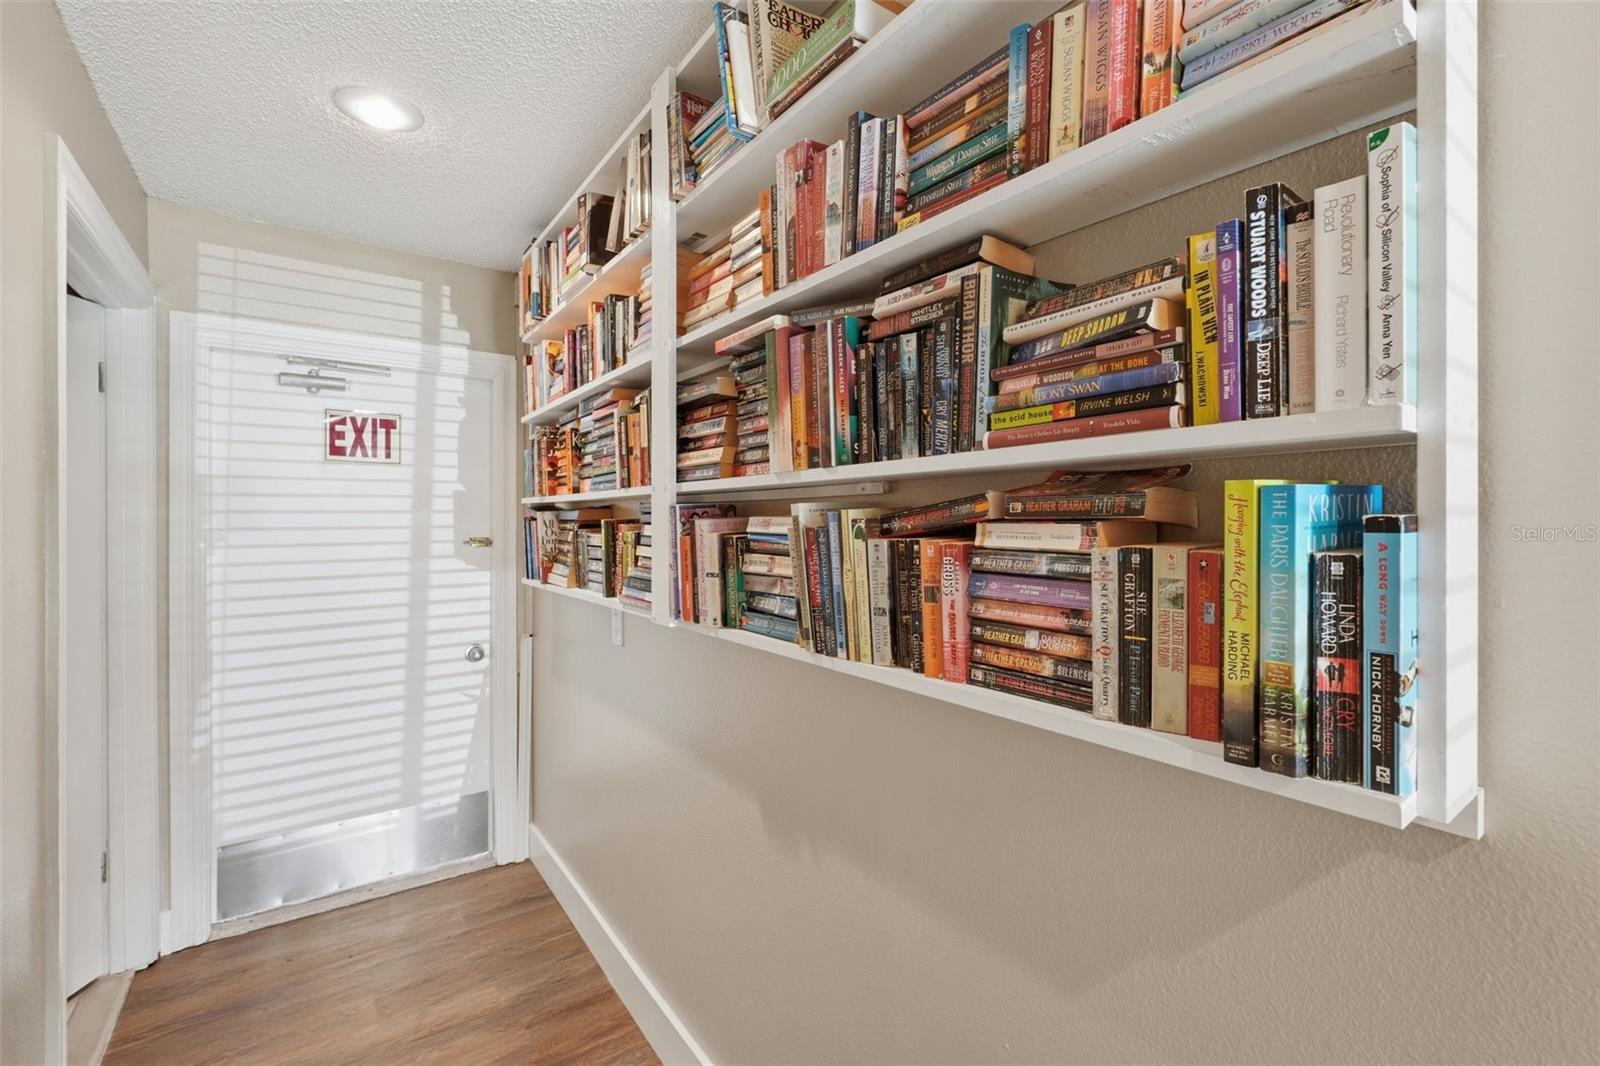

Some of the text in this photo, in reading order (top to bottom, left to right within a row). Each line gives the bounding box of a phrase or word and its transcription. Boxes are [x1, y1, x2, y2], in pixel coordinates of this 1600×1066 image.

[1114, 4, 1128, 80] SUSAN WIGGS
[1153, 12, 1165, 48] WIGGS
[1217, 34, 1270, 65] SHERRYL
[1273, 7, 1323, 38] WOODS
[1030, 50, 1038, 86] WIGGS
[1037, 47, 1046, 83] SUSAN
[1062, 47, 1074, 122] SUSAN WIGGS
[1095, 43, 1108, 92] WIGGS
[1012, 140, 1020, 164] WILDE
[884, 177, 892, 214] SPINDLER
[1322, 198, 1338, 234] Road
[1338, 194, 1356, 276] Revolutionary
[1380, 166, 1392, 292] Sophia of Silicon Valley
[1296, 238, 1311, 252] The
[1250, 212, 1268, 318] STUART WOODS
[910, 302, 943, 318] WHITLEY
[910, 310, 944, 326] STRIEBER
[962, 281, 976, 320] BRAD
[1060, 306, 1091, 318] MADISON
[1094, 296, 1125, 308] COUNTY
[1194, 270, 1218, 345] IN PLAIN VIEW
[962, 324, 974, 364] THOR
[1060, 310, 1127, 347] DEEP SHADOW
[1336, 295, 1348, 368] Richard Yates
[1382, 314, 1392, 359] Anna Yen
[936, 334, 946, 377] STEWART
[1098, 357, 1148, 373] AT THE BONE
[1256, 342, 1272, 402] DEEP LIE
[1006, 370, 1074, 390] JACQUELINE WOODSON
[1067, 380, 1100, 395] SWAN
[994, 408, 1052, 425] the acid house
[1079, 392, 1150, 410] IRVINE WELSH
[329, 414, 397, 459] EXIT
[935, 400, 948, 452] CRY MERCY
[1026, 500, 1091, 512] HEATHER GRAHAM
[1272, 490, 1288, 518] THE
[1309, 494, 1373, 522] KRISTIN
[983, 560, 1040, 571] HEATHER GRAHAM
[1228, 494, 1249, 622] Hanging with the Elephant
[1272, 524, 1288, 568] PARIS
[911, 578, 917, 586] OF
[943, 556, 955, 596] GROSS
[1378, 542, 1388, 644] A LONG WAY DOWN
[1100, 582, 1108, 642] SUE GRAFTON
[1124, 573, 1135, 632] GRAFTON
[1136, 592, 1146, 616] SUE
[1270, 573, 1288, 658] DAUGHTER
[874, 616, 882, 654] GRISHAM
[983, 630, 1010, 643] HEATHER
[1158, 610, 1170, 668] PAYMENT IN BLOOD
[1171, 611, 1184, 674] ELIZABETH GEORGE
[1320, 592, 1338, 654] HOWARD
[1339, 604, 1356, 643] LINDA
[912, 634, 920, 669] GRISHAM
[986, 651, 1046, 673] HEATHER GRAHAM
[1096, 645, 1111, 657] Q
[1129, 645, 1140, 653] P
[1228, 630, 1238, 680] HARDING
[1240, 632, 1250, 680] MICHAEL
[1057, 664, 1093, 681] SILENCED
[1102, 664, 1110, 676] for
[1100, 676, 1110, 706] Quarry
[1372, 656, 1382, 752] NICK HORNBY
[1264, 688, 1277, 744] HARMEL
[1280, 692, 1293, 748] KRISTIN
[1322, 706, 1334, 757] NO MORE
[1336, 698, 1354, 732] CRY
